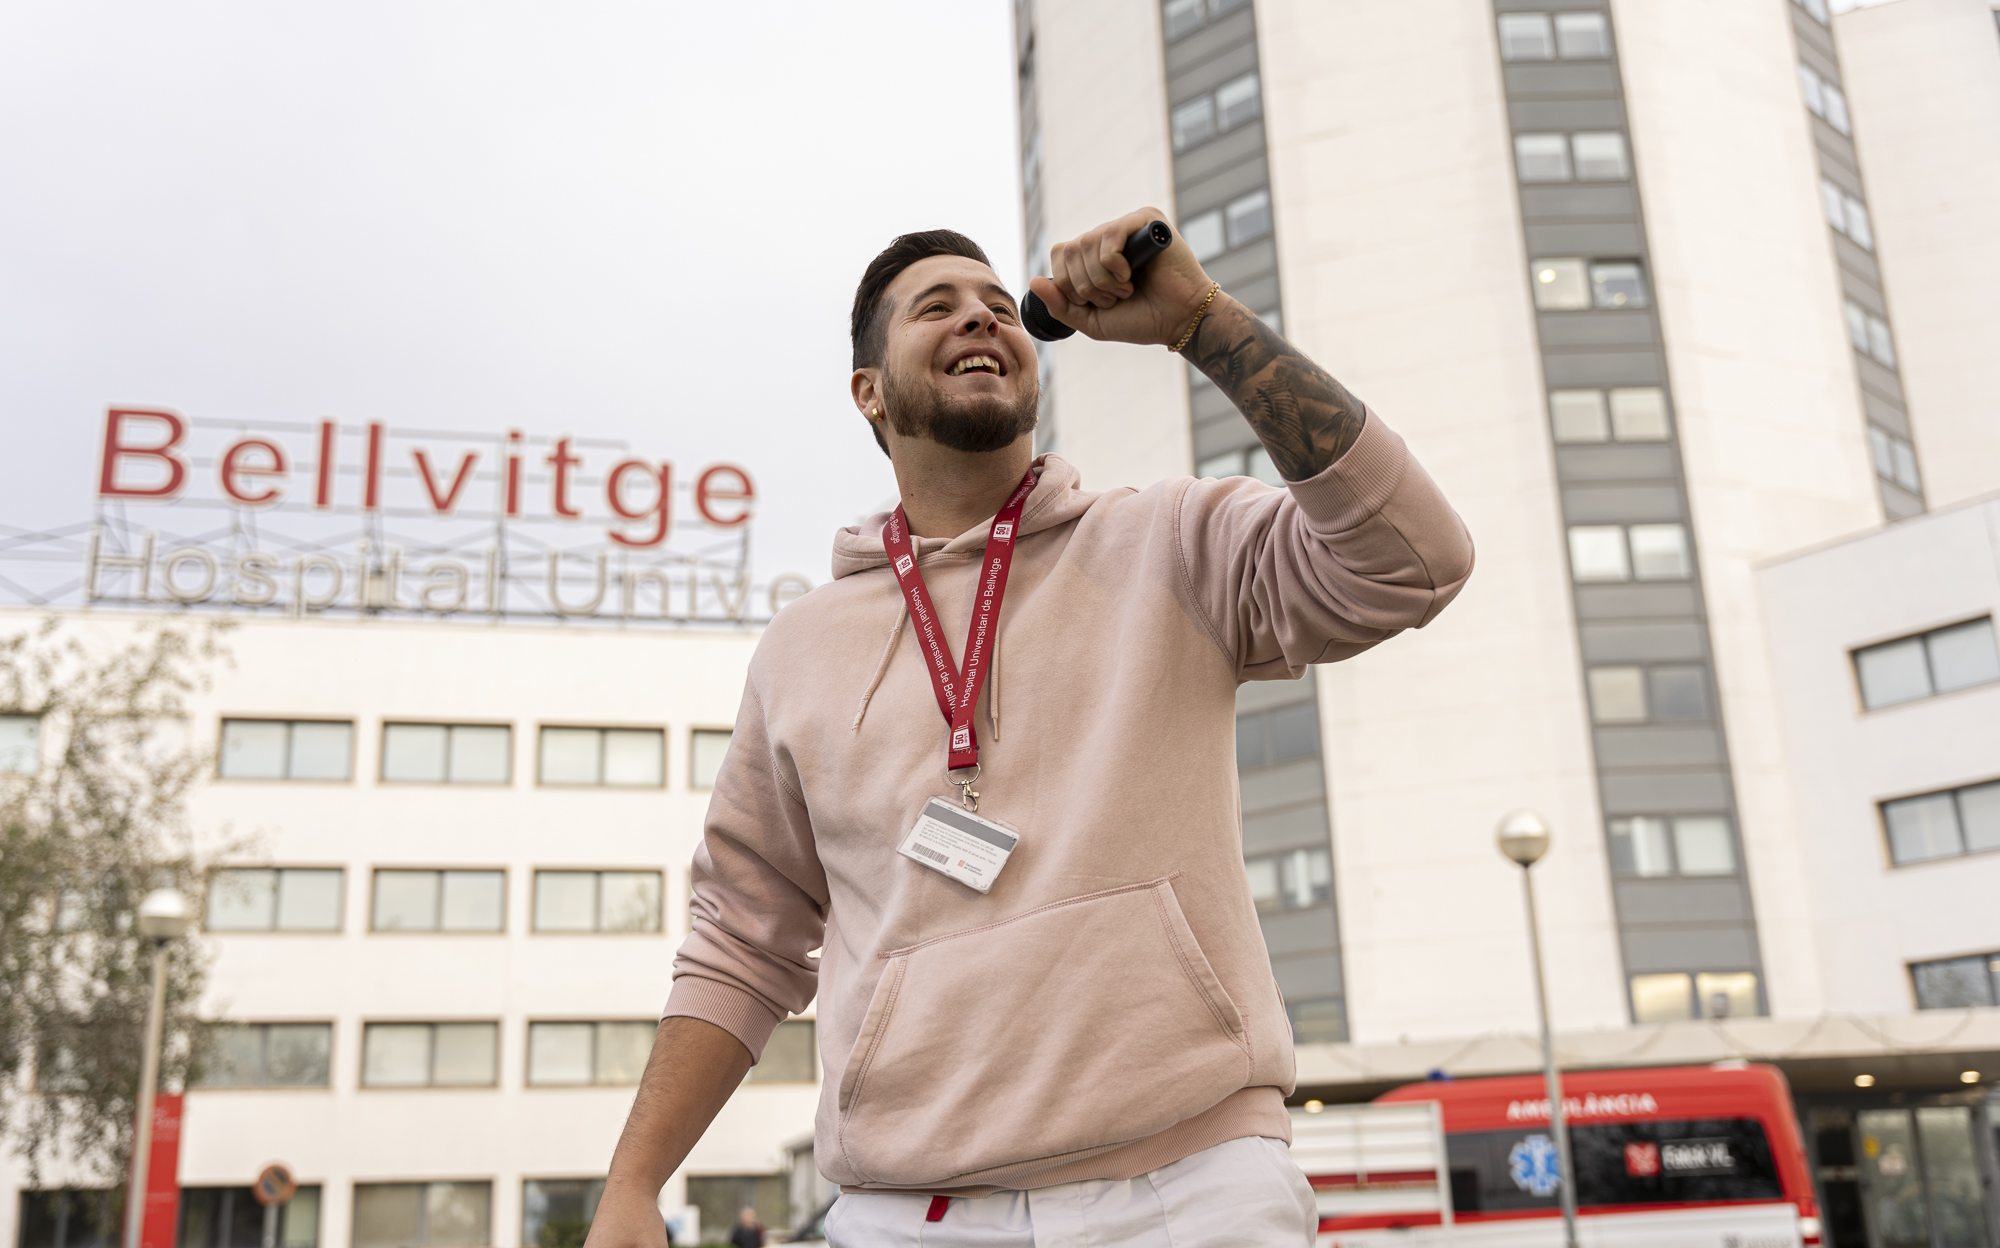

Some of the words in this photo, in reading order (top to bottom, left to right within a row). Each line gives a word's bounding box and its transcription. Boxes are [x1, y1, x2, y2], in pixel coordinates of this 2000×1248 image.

[98, 408, 756, 548] Bellvitge
[996, 526, 1006, 535] 50
[86, 532, 497, 614] Hospital
[545, 548, 815, 620] Unive
[983, 557, 1002, 597] Bellvitge
[981, 599, 992, 611] de
[910, 586, 930, 623] Hospital
[923, 621, 948, 672] Universitari
[940, 671, 950, 683] de
[969, 613, 989, 667] Universitari
[960, 668, 977, 708] Hospital
[955, 733, 964, 745] 50
